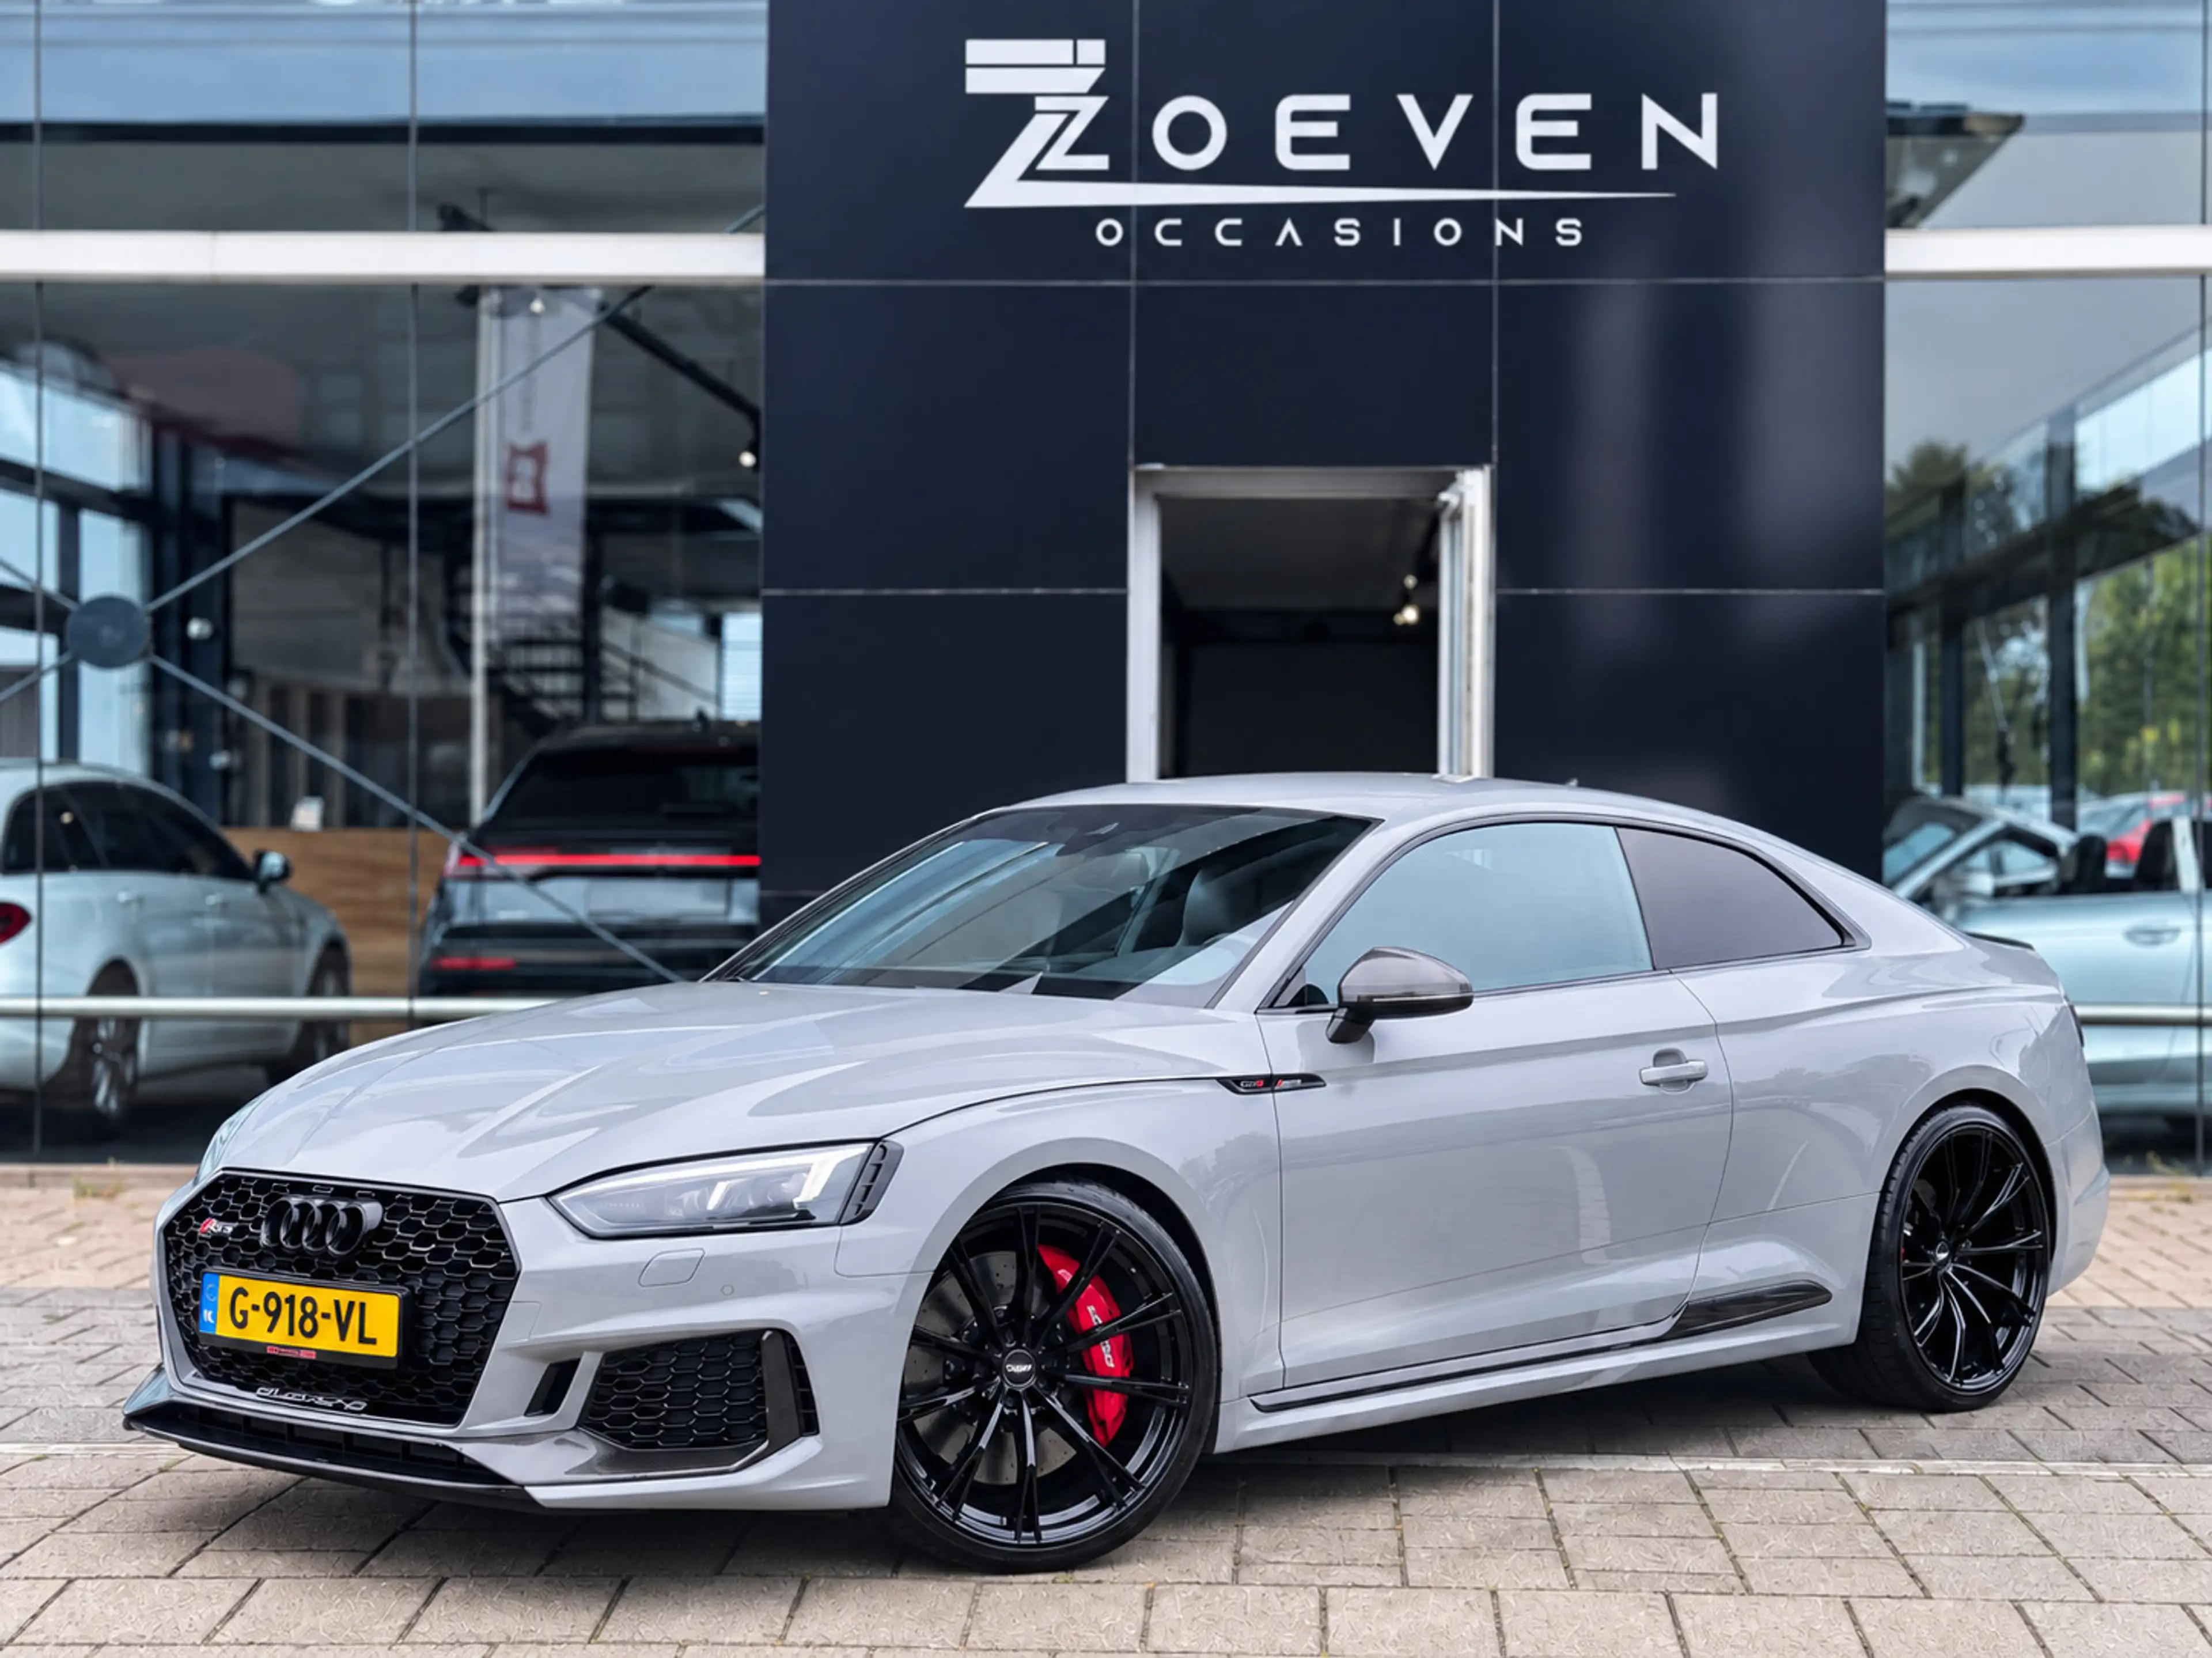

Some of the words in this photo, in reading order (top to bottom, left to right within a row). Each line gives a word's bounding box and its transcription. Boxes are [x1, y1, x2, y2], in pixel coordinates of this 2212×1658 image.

[964, 39, 1718, 209] ZOEVEN
[1095, 218, 1582, 247] OCCASIONS
[229, 1286, 378, 1346] G-918-VL
